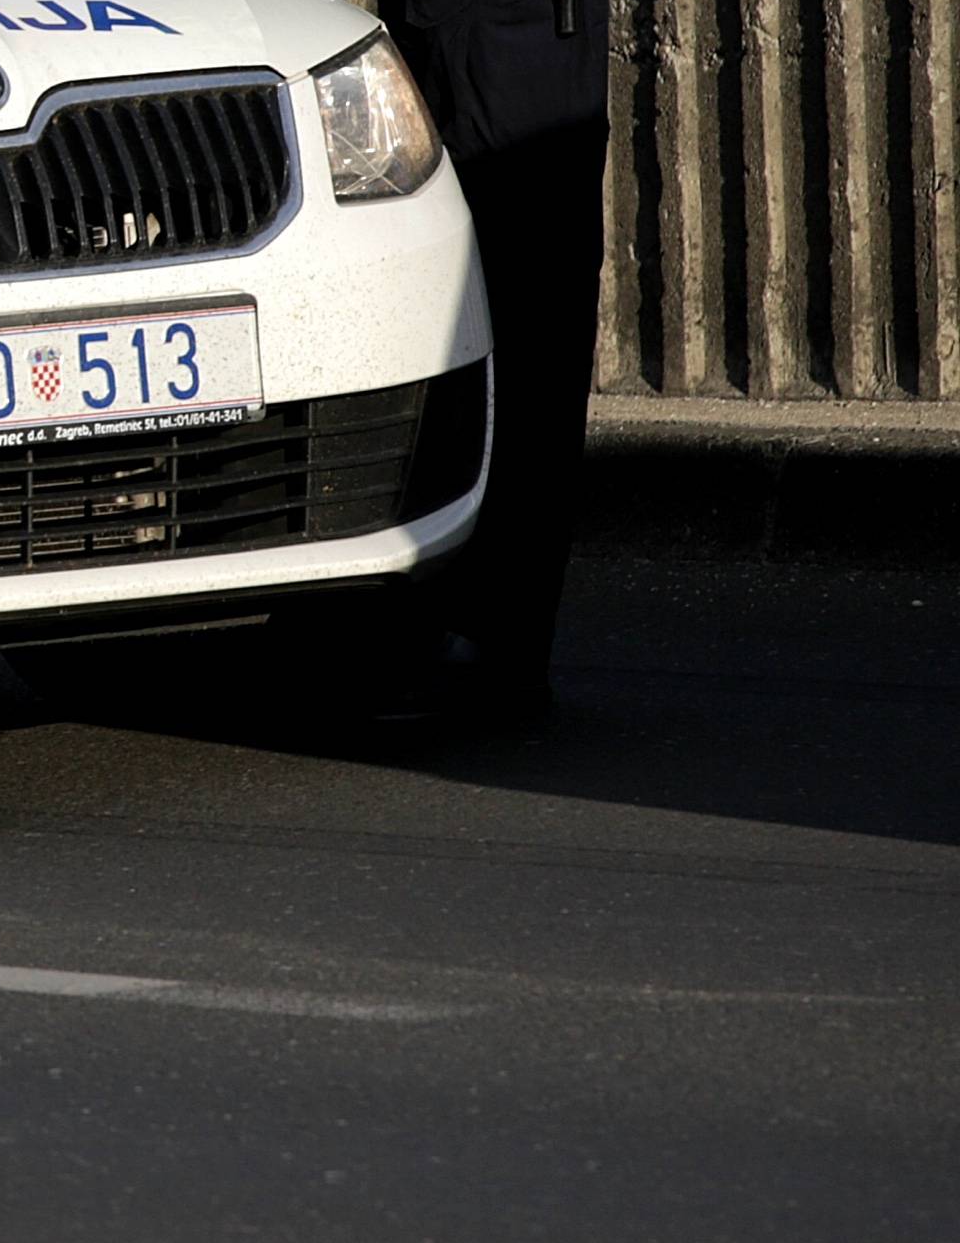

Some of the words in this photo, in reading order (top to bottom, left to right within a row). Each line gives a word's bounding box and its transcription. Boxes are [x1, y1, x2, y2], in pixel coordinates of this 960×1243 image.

[77, 322, 201, 410] 513
[27, 428, 48, 442] d.d.
[54, 423, 93, 441] Zagreb,
